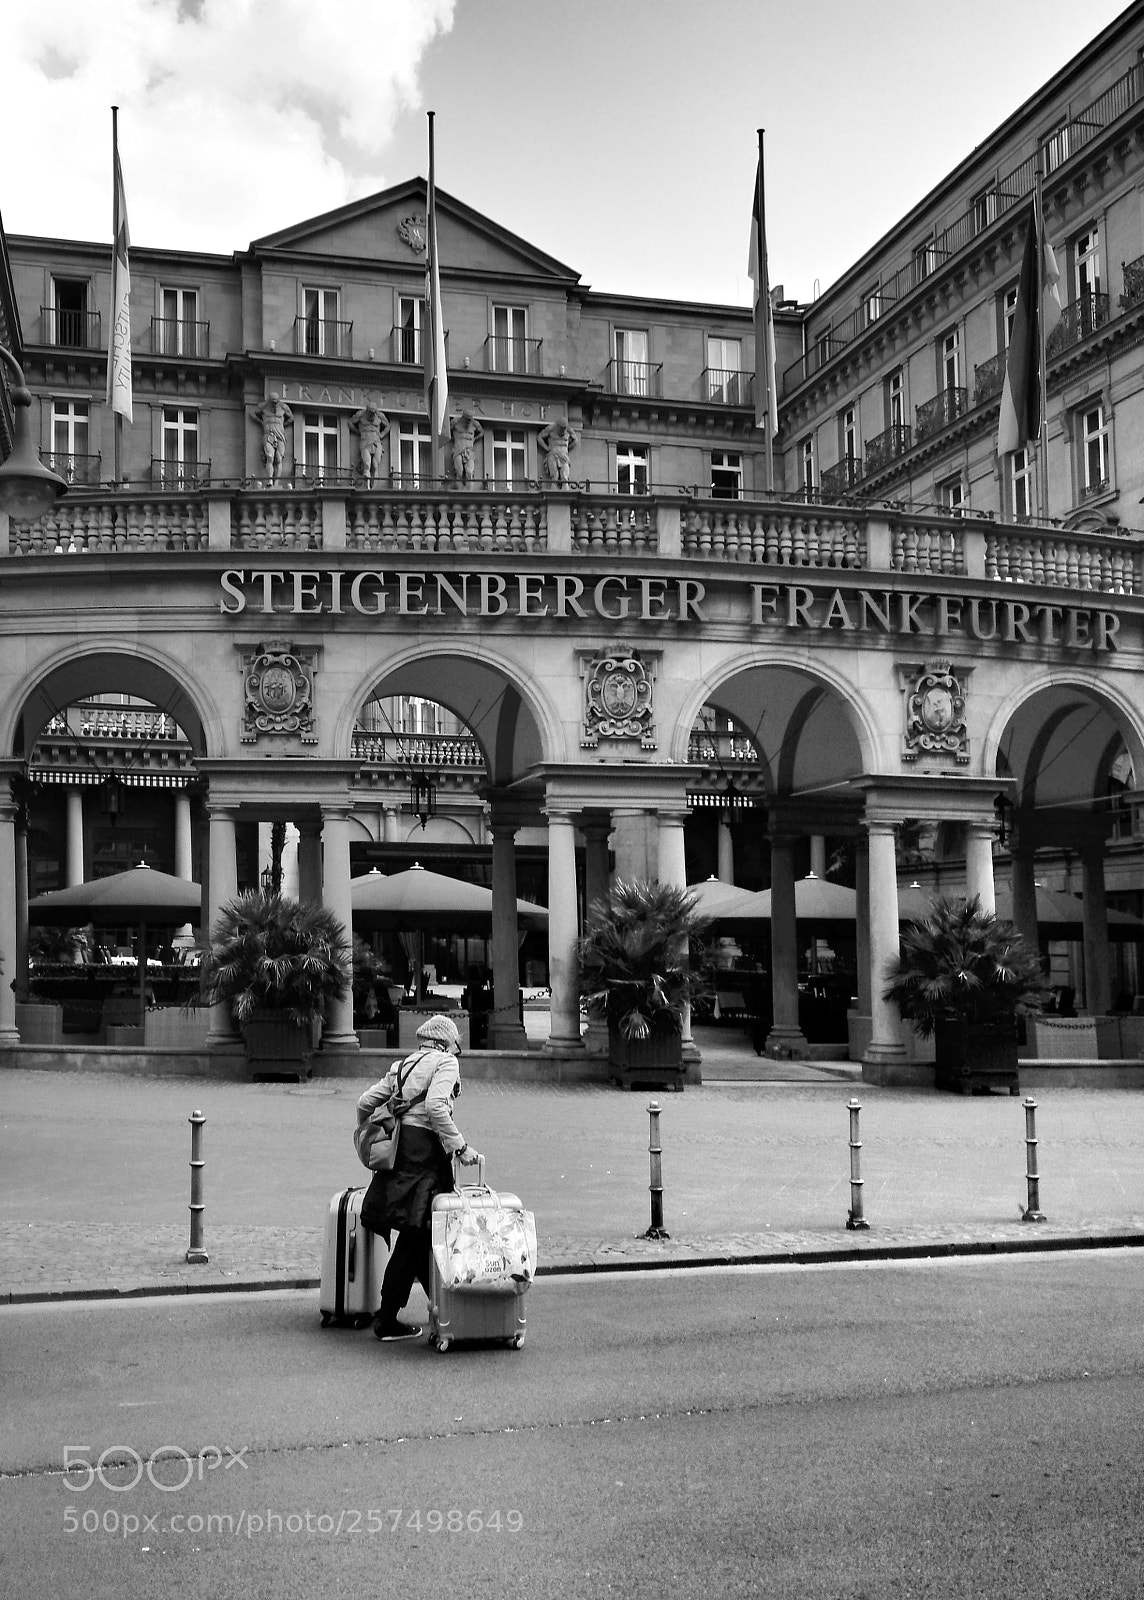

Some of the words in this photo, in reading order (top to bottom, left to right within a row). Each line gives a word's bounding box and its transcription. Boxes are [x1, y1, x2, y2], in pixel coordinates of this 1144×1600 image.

[502, 400, 551, 420] HOF
[219, 569, 707, 622] STEIGENBERGER
[750, 583, 1122, 651] FRANKFURTER
